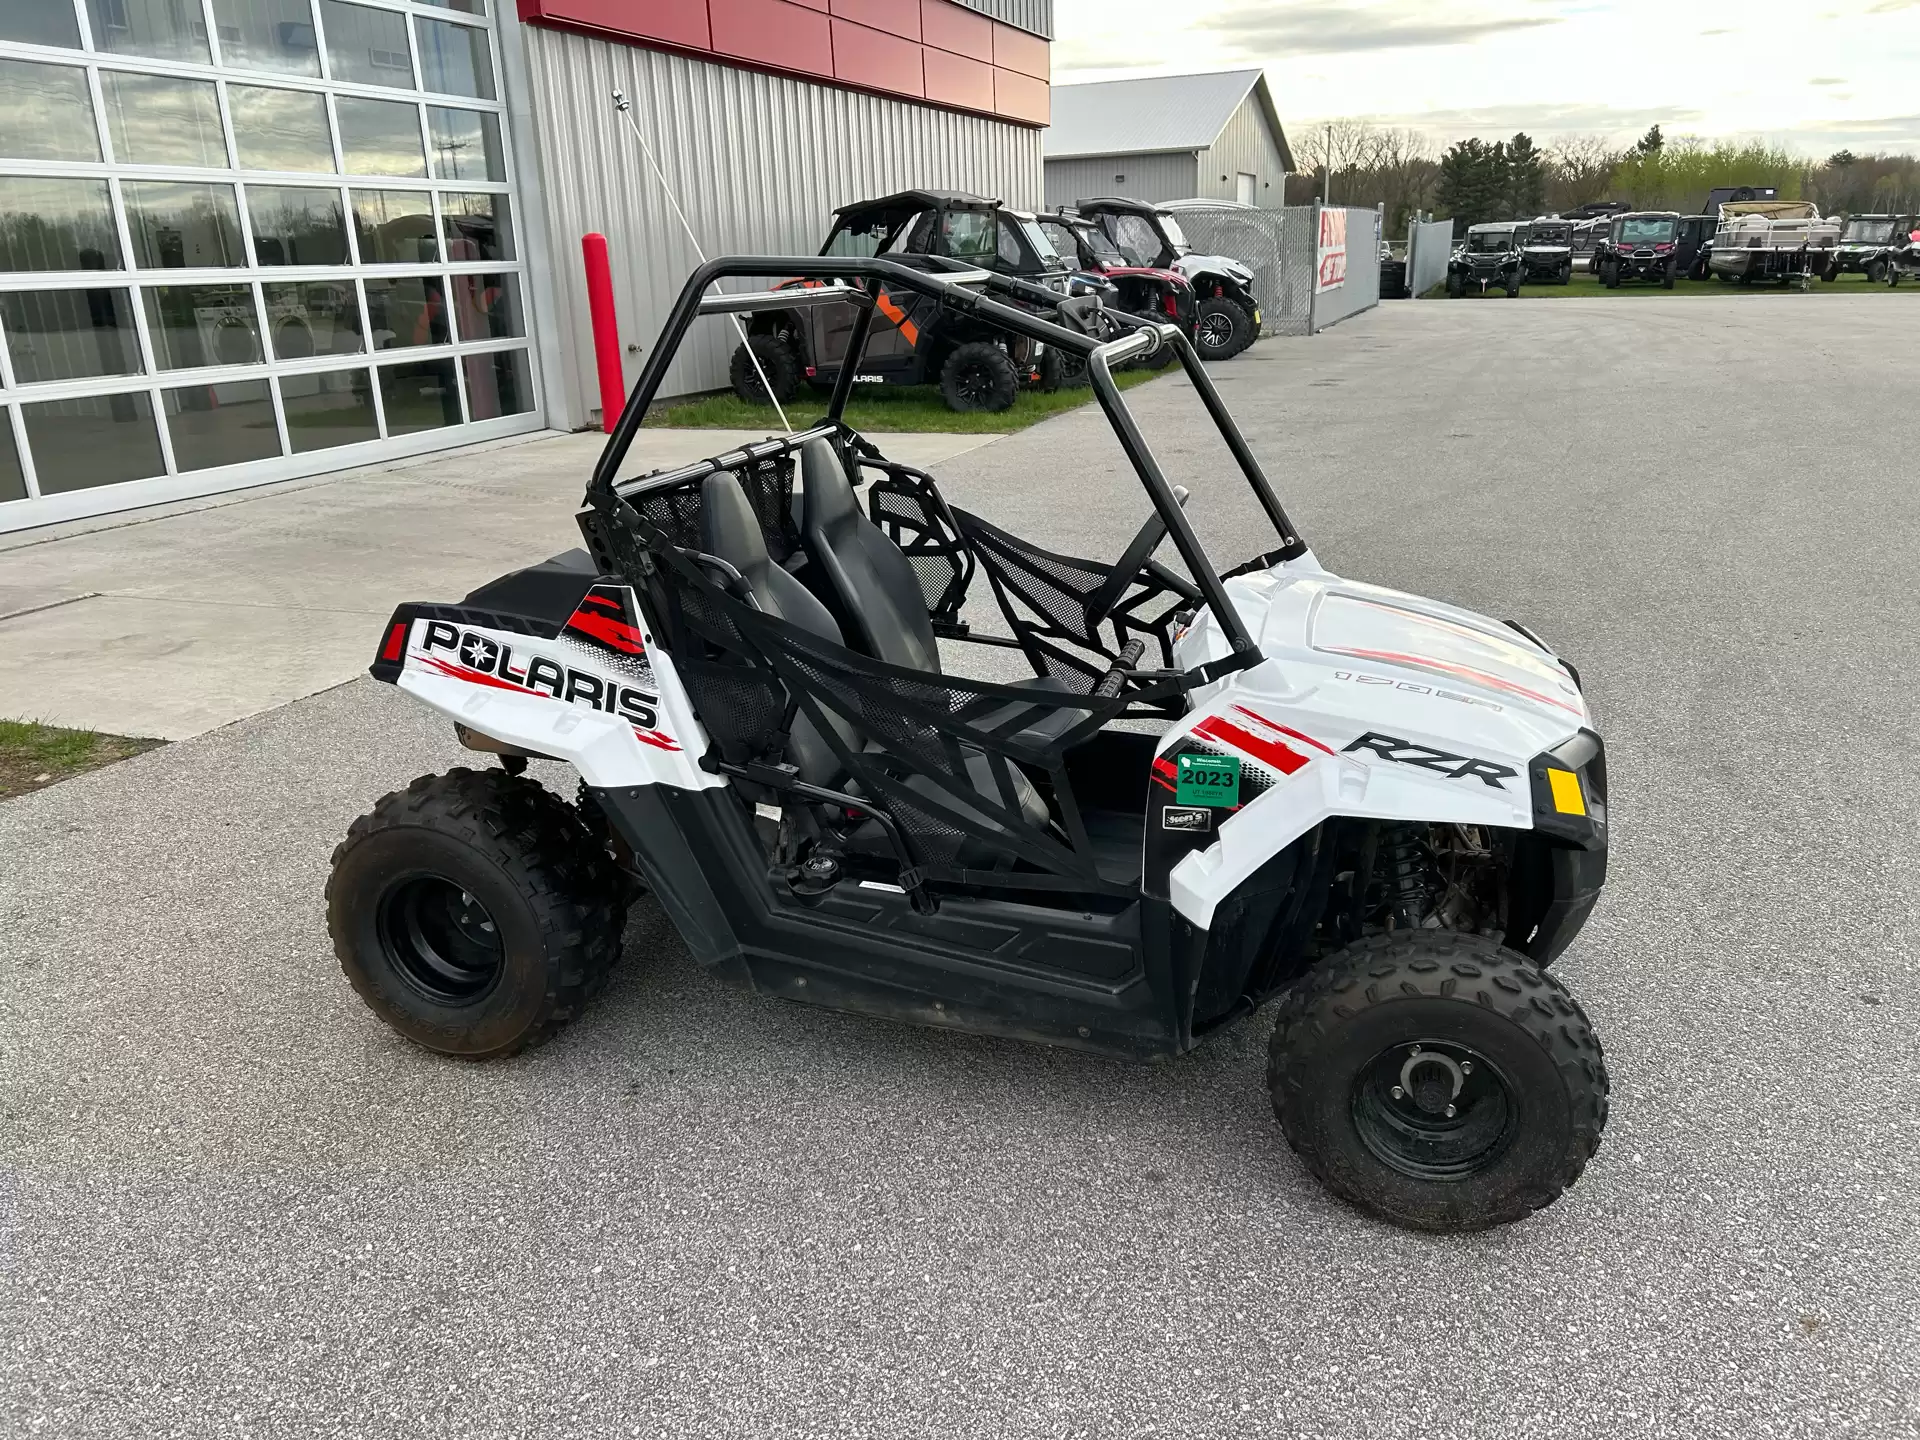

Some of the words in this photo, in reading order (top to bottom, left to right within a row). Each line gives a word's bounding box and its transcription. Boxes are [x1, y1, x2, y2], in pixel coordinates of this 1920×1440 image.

[852, 374, 884, 383] LARIS
[422, 620, 659, 730] POLARIS
[1182, 770, 1234, 787] 2023
[1340, 731, 1519, 791] RZR
